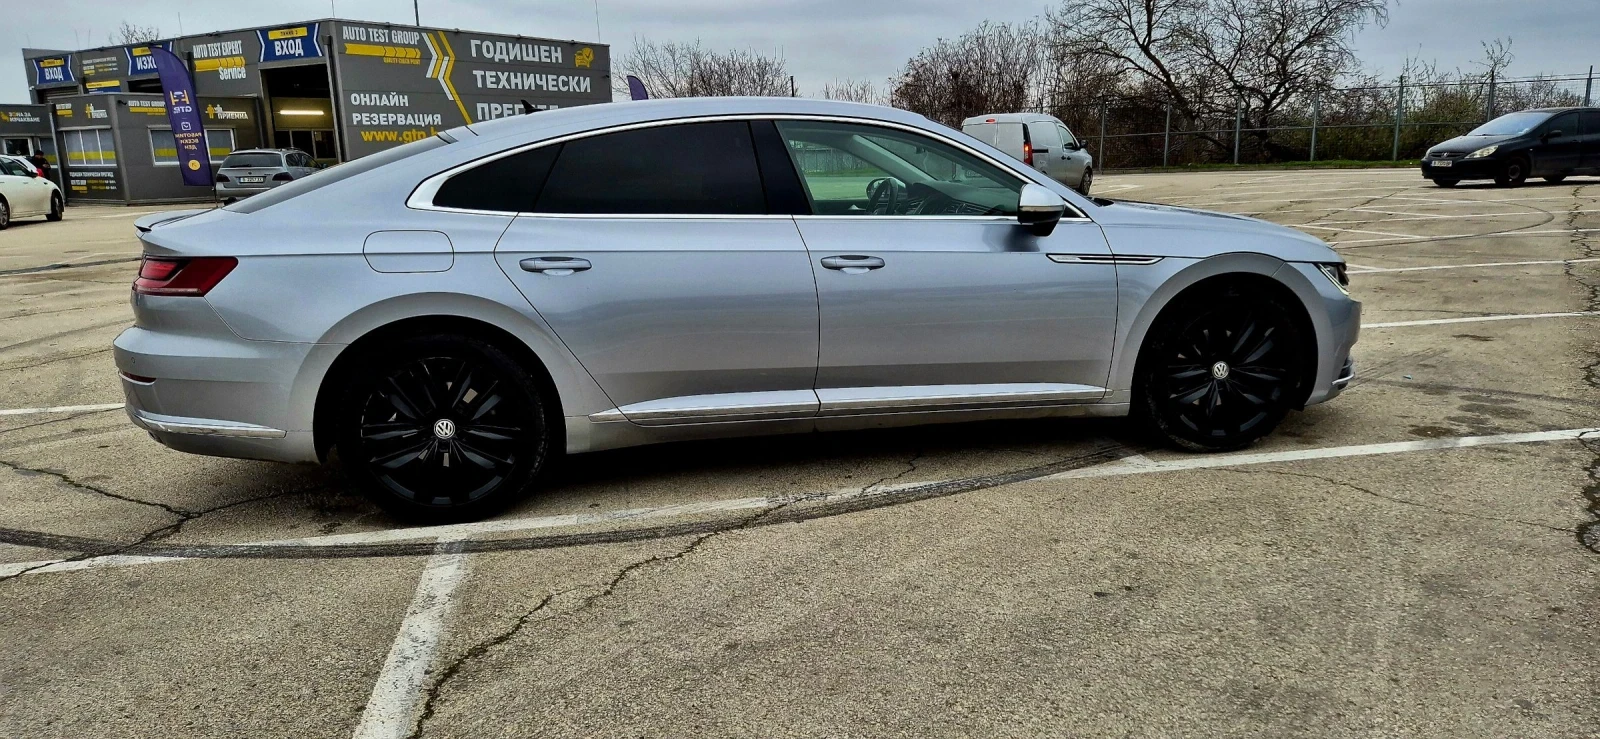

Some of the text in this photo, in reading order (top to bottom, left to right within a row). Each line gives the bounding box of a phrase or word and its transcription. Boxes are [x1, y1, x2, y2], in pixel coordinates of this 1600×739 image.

[342, 26, 420, 45] AUTO TEST GROUP
[193, 40, 243, 58] AUTO TEST EXPERT
[274, 38, 304, 56] ВХОД
[470, 39, 563, 63] ГОДИШЕН
[136, 55, 158, 70] ИЗХ
[44, 67, 64, 81] ВХОД
[219, 66, 246, 80] Service
[472, 70, 591, 93] ТЕХНИЧЕСКИ
[350, 92, 409, 106] ОНЛАЙН
[352, 112, 442, 127] РЕЗЕРВАЦИЯ
